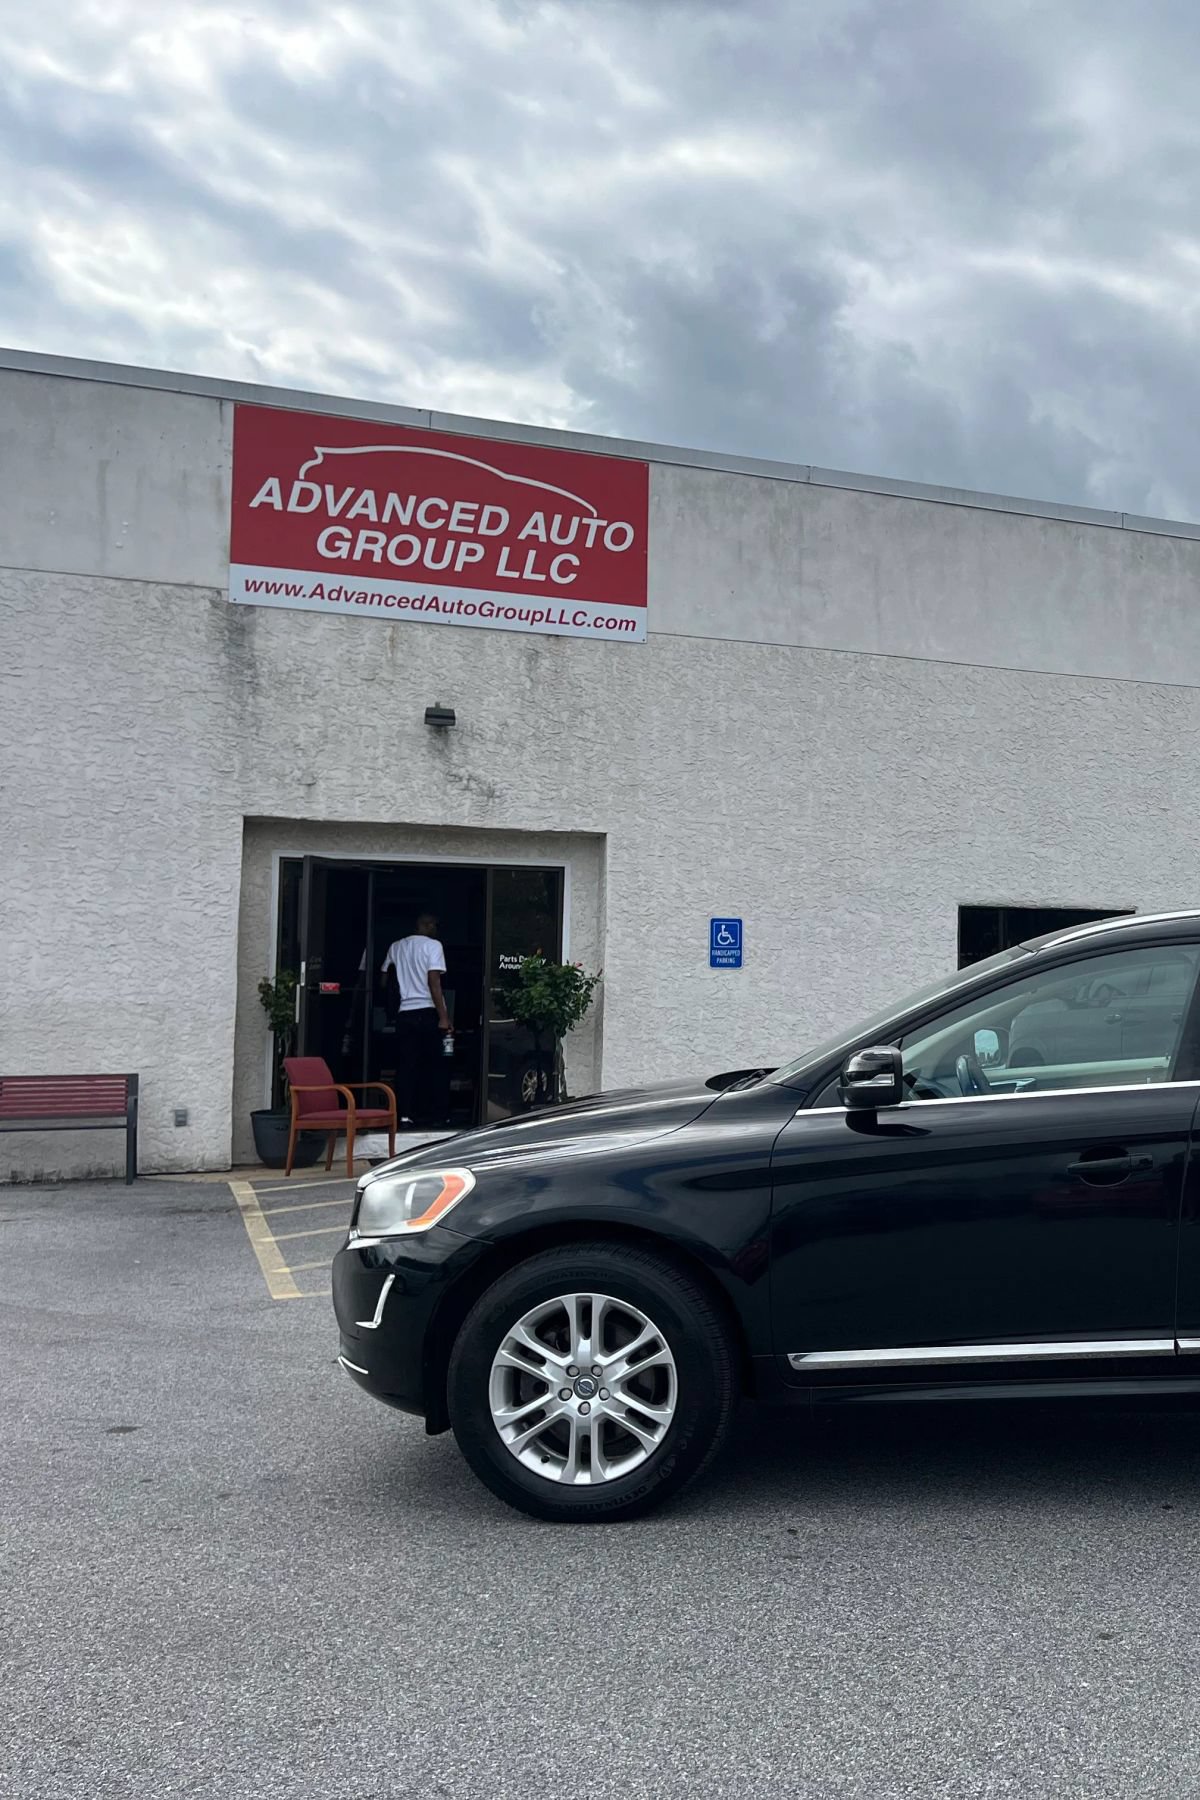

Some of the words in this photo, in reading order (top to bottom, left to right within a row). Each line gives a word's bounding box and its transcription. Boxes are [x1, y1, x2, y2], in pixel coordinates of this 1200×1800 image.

[249, 477, 509, 537] ADVANCED
[517, 511, 635, 552] AUTO
[316, 525, 485, 572] GROUP
[496, 546, 580, 584] LLC
[244, 579, 637, 632] www.AdvancedAutoGroupLLC.com
[499, 954, 518, 963] Parts
[499, 961, 524, 970] Aroun
